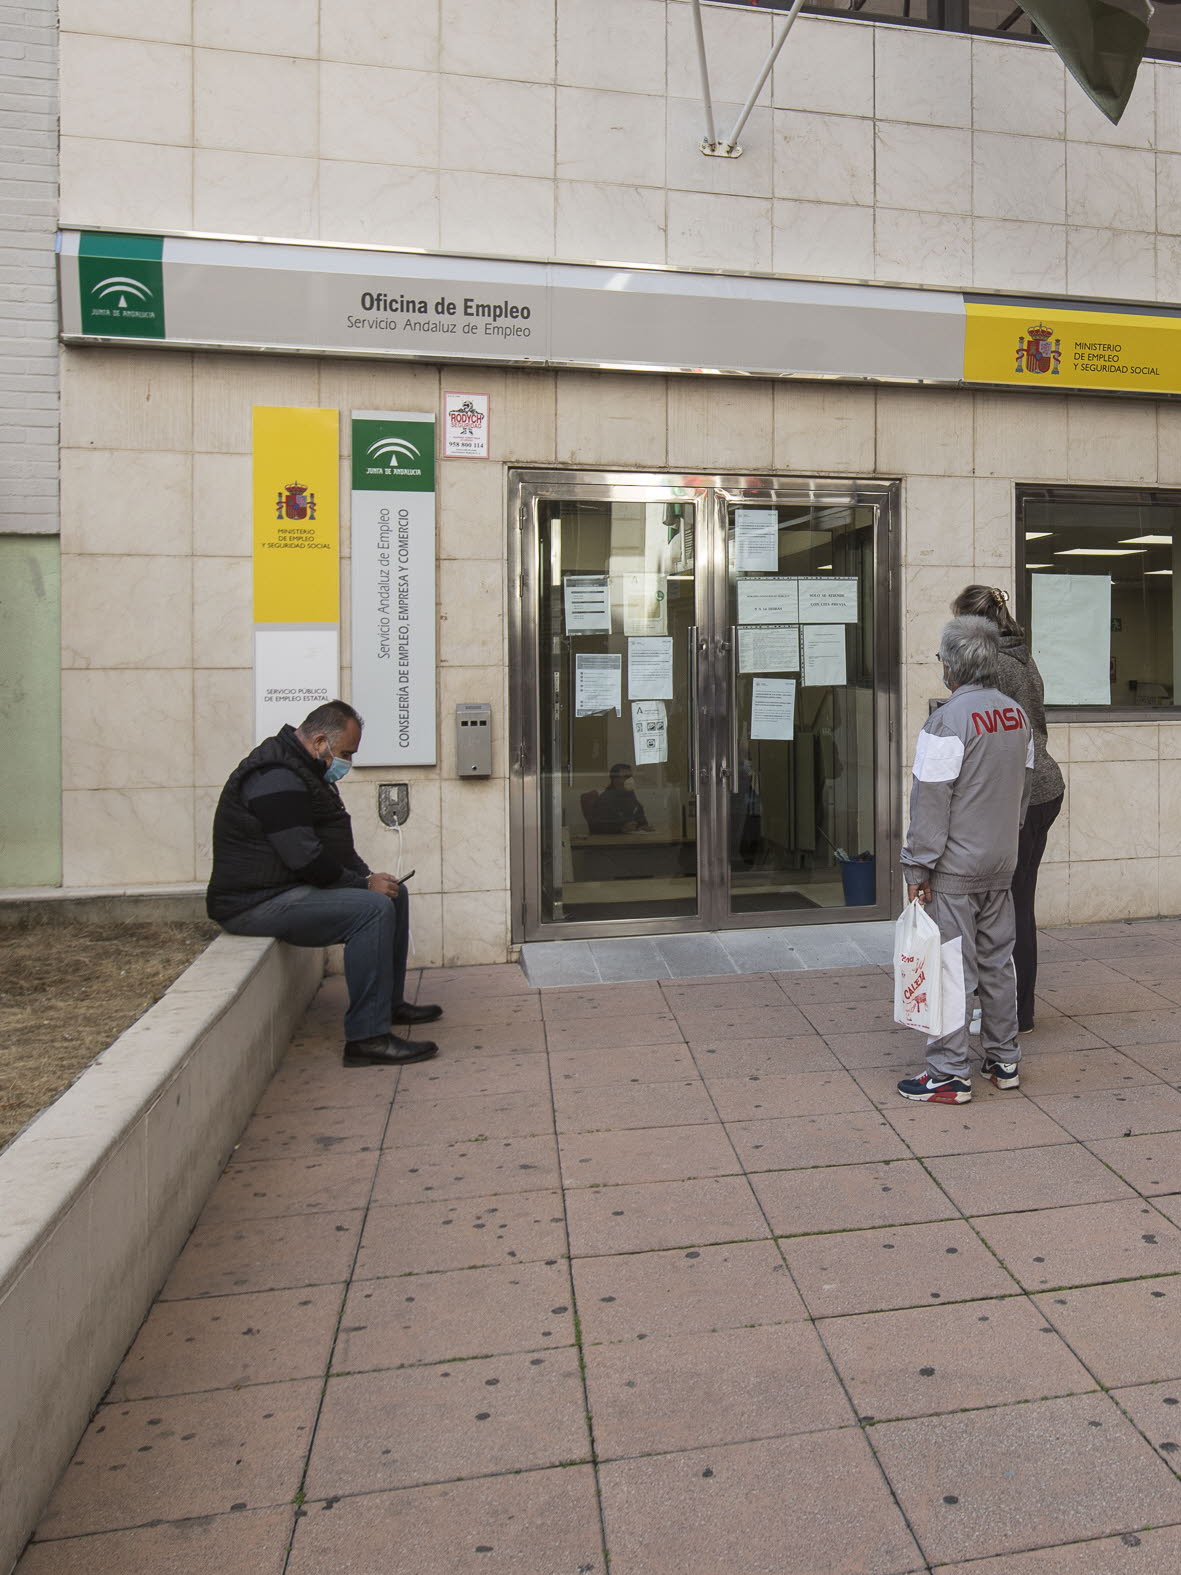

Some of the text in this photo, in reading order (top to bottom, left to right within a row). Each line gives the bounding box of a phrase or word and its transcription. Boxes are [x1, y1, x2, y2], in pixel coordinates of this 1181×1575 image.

[361, 291, 531, 322] Oficina de Empleo
[347, 315, 531, 340] Servicio Andaluz de Empleo
[1074, 342, 1122, 353] MINISTERIO
[1087, 353, 1120, 363] EMPLEO
[1080, 363, 1128, 374] SEGURIDAD
[1130, 366, 1160, 375] SOCIAL
[450, 413, 482, 424] RODYCH
[398, 509, 409, 564] COMERCIO
[377, 508, 393, 659] Servicio Andaluz de Empleo
[398, 574, 409, 620] EMPRESA
[398, 623, 410, 666] EMPLEO,
[398, 670, 409, 683] DE
[396, 686, 409, 748] CONSEJERÍA
[971, 707, 1028, 735] NASA
